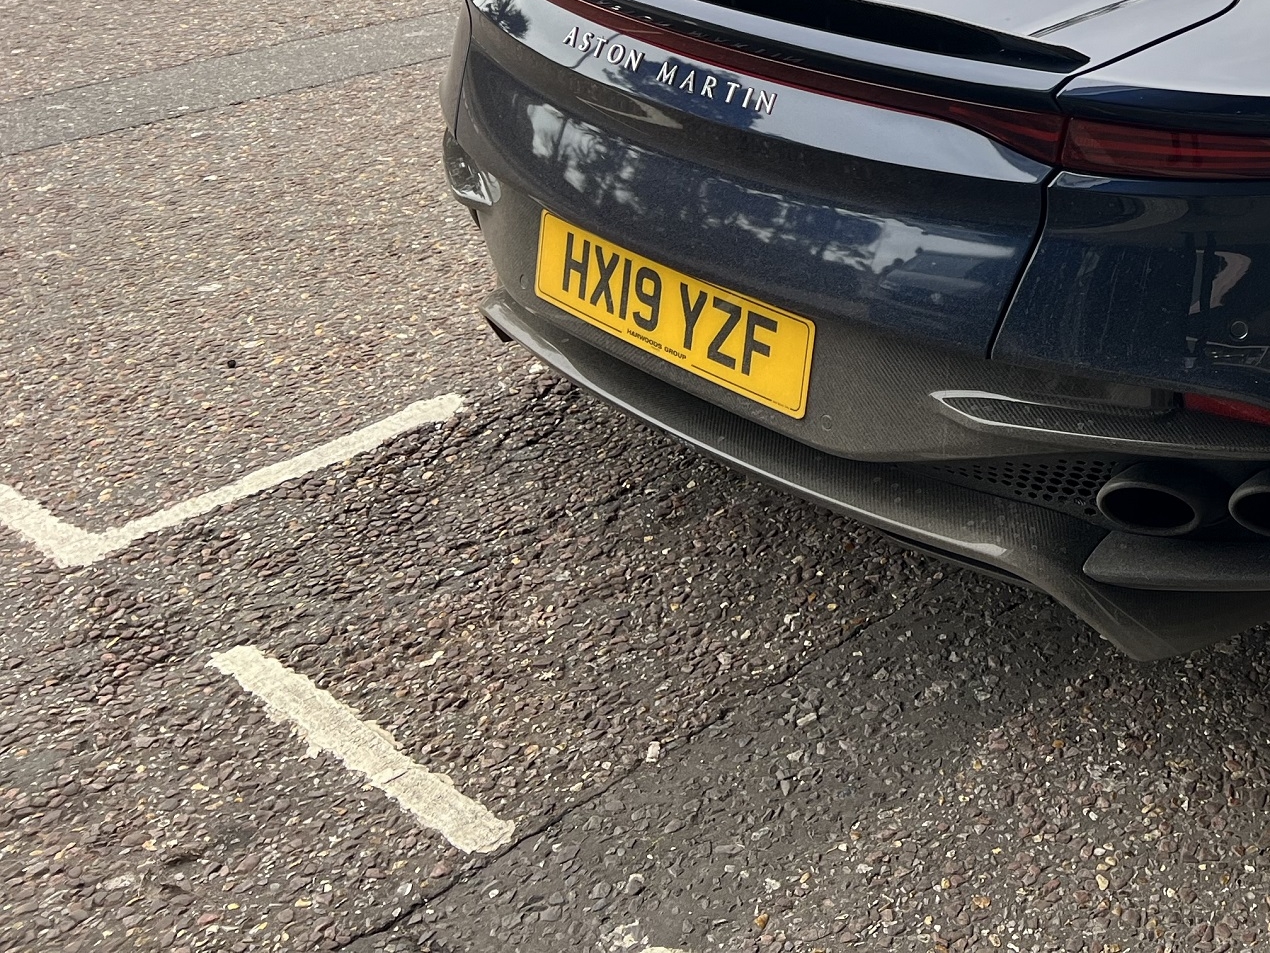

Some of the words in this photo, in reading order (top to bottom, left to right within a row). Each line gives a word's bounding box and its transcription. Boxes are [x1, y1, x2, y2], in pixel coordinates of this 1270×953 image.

[563, 26, 645, 72] ASTON
[656, 61, 778, 115] MARTIN
[562, 232, 663, 332] HX19
[679, 282, 778, 376] YZF
[627, 328, 663, 350] HARWOODS
[664, 346, 687, 360] GROUP
